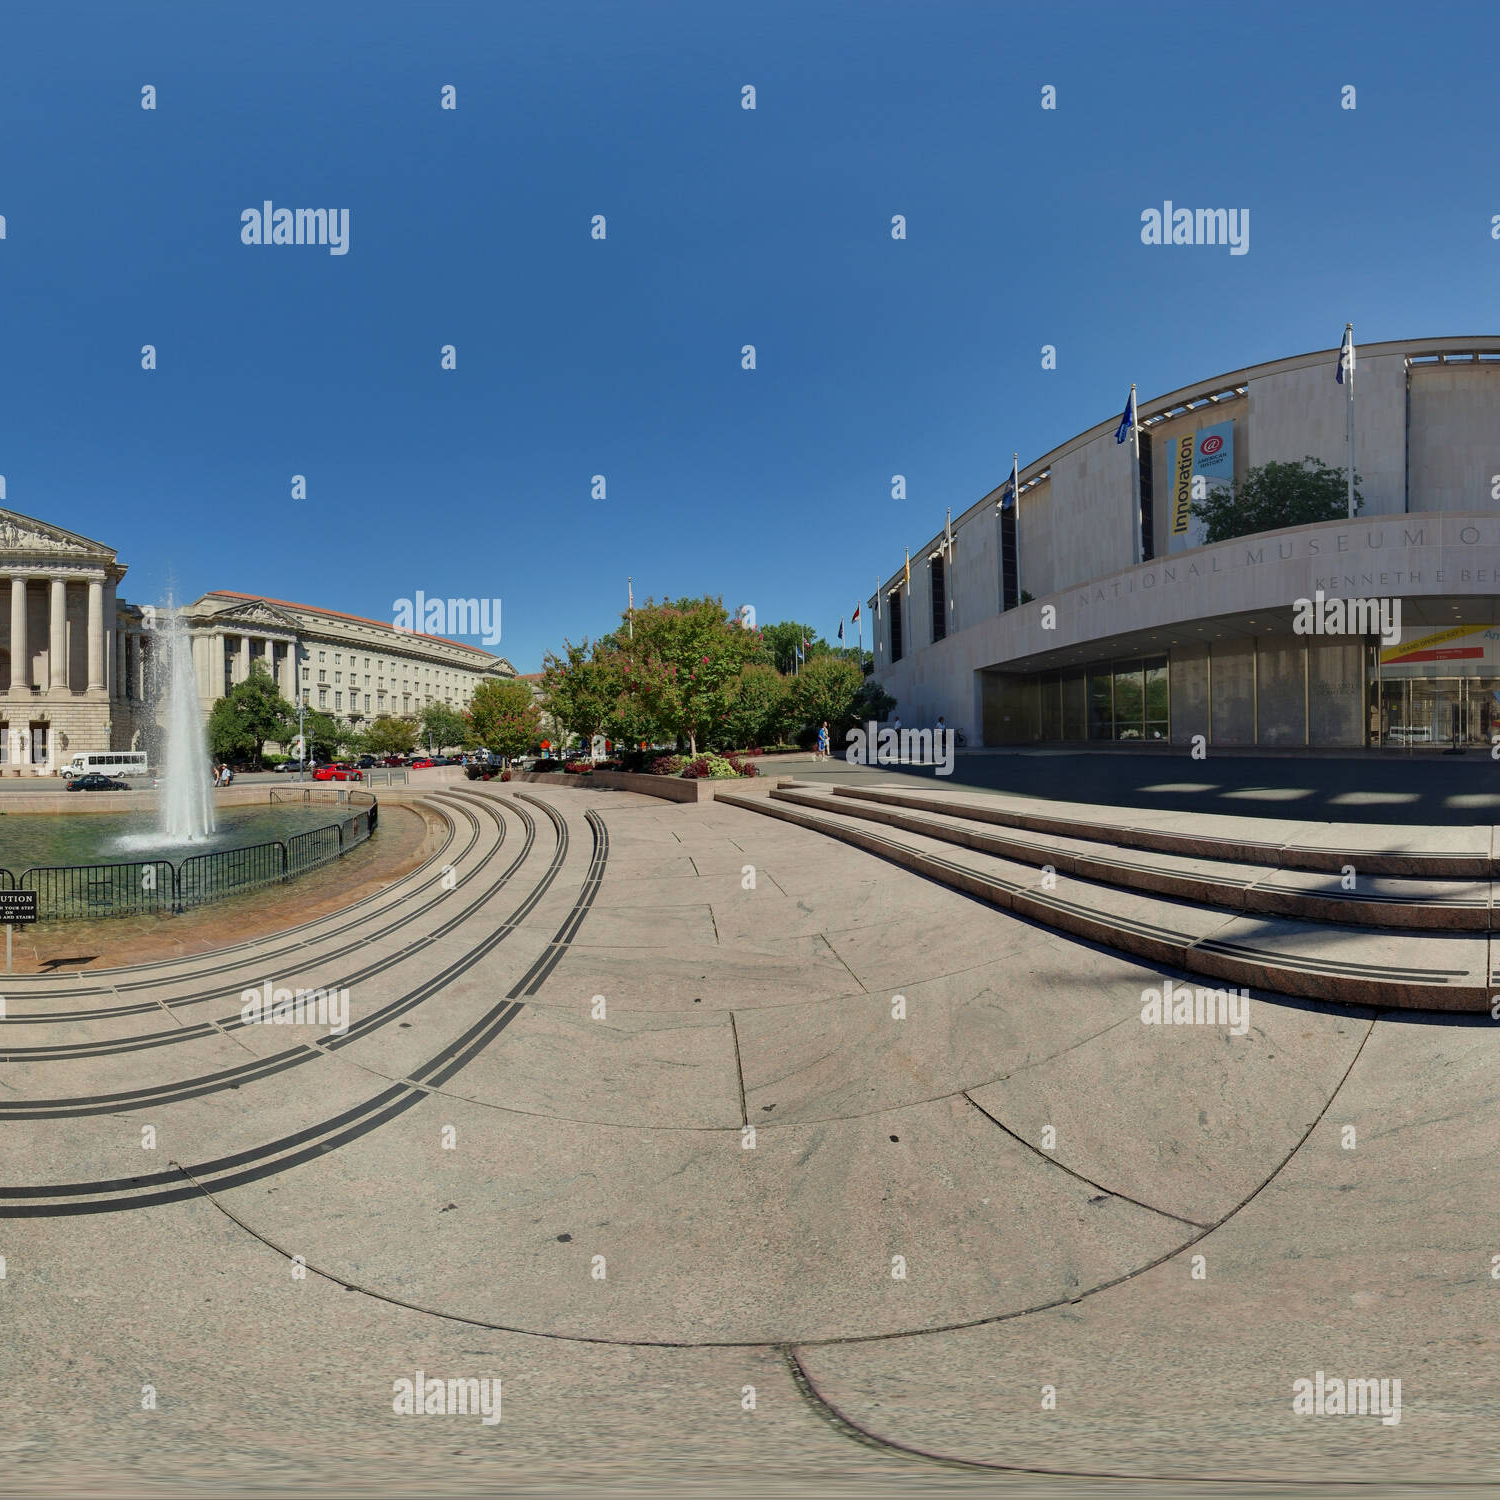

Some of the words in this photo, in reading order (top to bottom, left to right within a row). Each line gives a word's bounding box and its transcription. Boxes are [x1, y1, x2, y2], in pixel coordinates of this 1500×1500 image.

[1197, 452, 1227, 465] AMERICAN
[1200, 458, 1224, 469] HISTORY
[1174, 436, 1193, 533] Innovation
[1079, 557, 1222, 607] NATIONAL
[1246, 529, 1424, 566] MUSEUM
[1316, 571, 1422, 591] KENNETH
[1436, 570, 1445, 582] E
